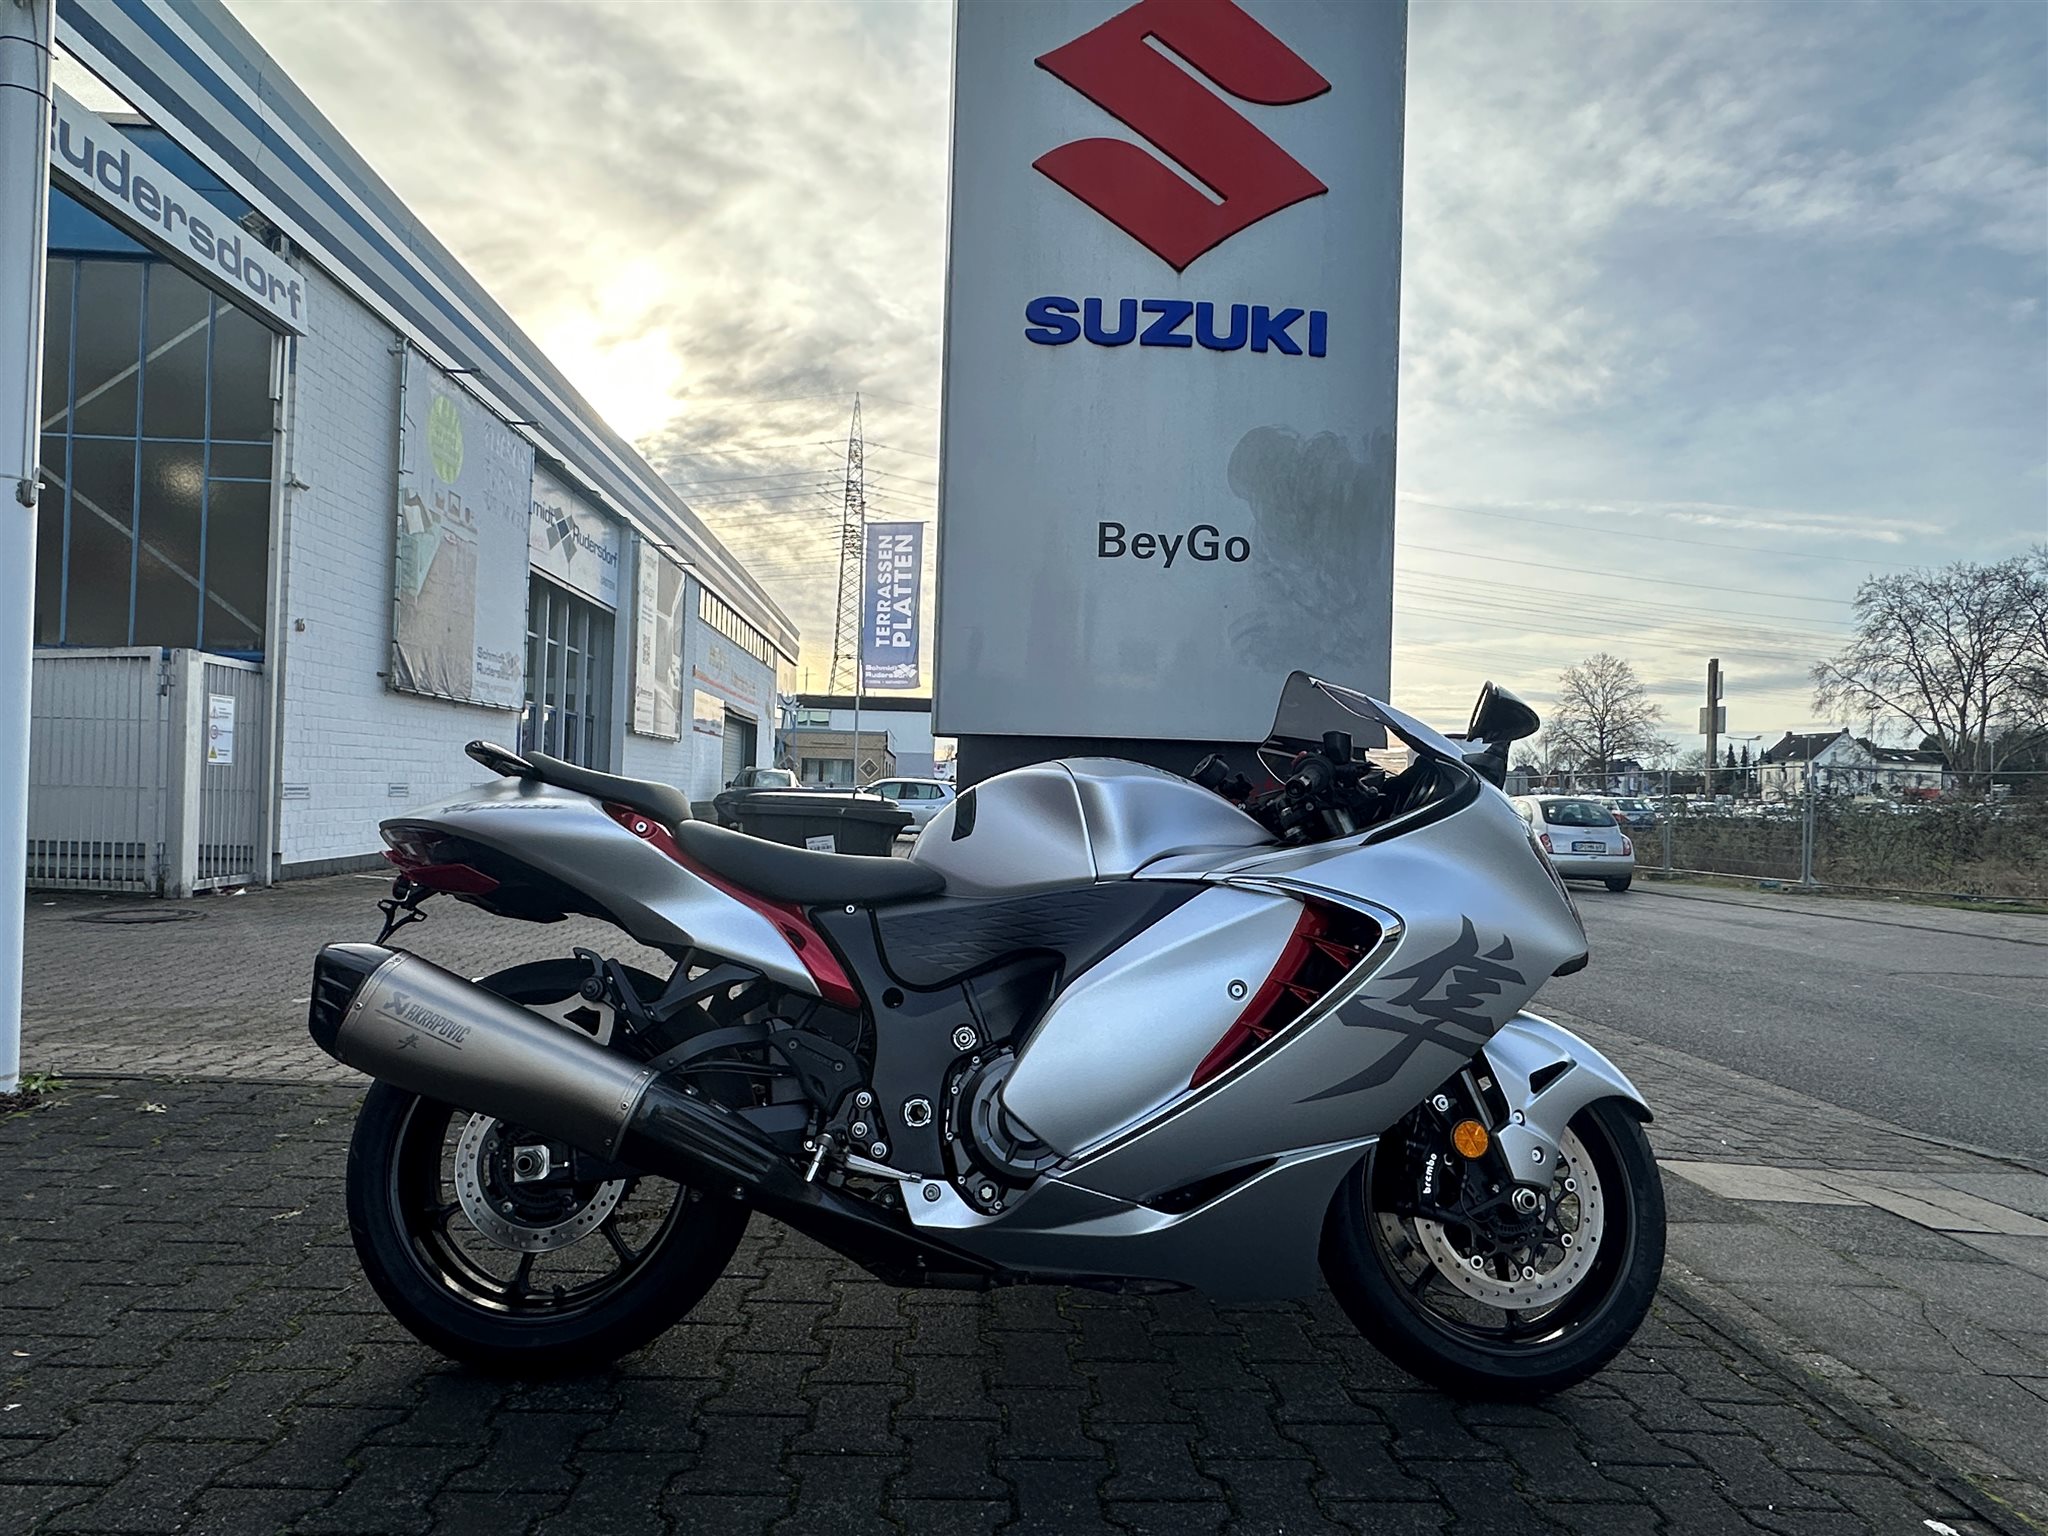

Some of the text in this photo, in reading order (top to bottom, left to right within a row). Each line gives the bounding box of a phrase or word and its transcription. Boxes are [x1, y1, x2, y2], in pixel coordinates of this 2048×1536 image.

[1025, 296, 1328, 358] SUZUKI
[573, 523, 618, 568] Rudersdorf
[1097, 521, 1251, 569] BeyGo
[875, 535, 893, 648] TERRASSEN
[892, 534, 914, 648] PLATTEN
[1422, 1153, 1438, 1194] brembo
